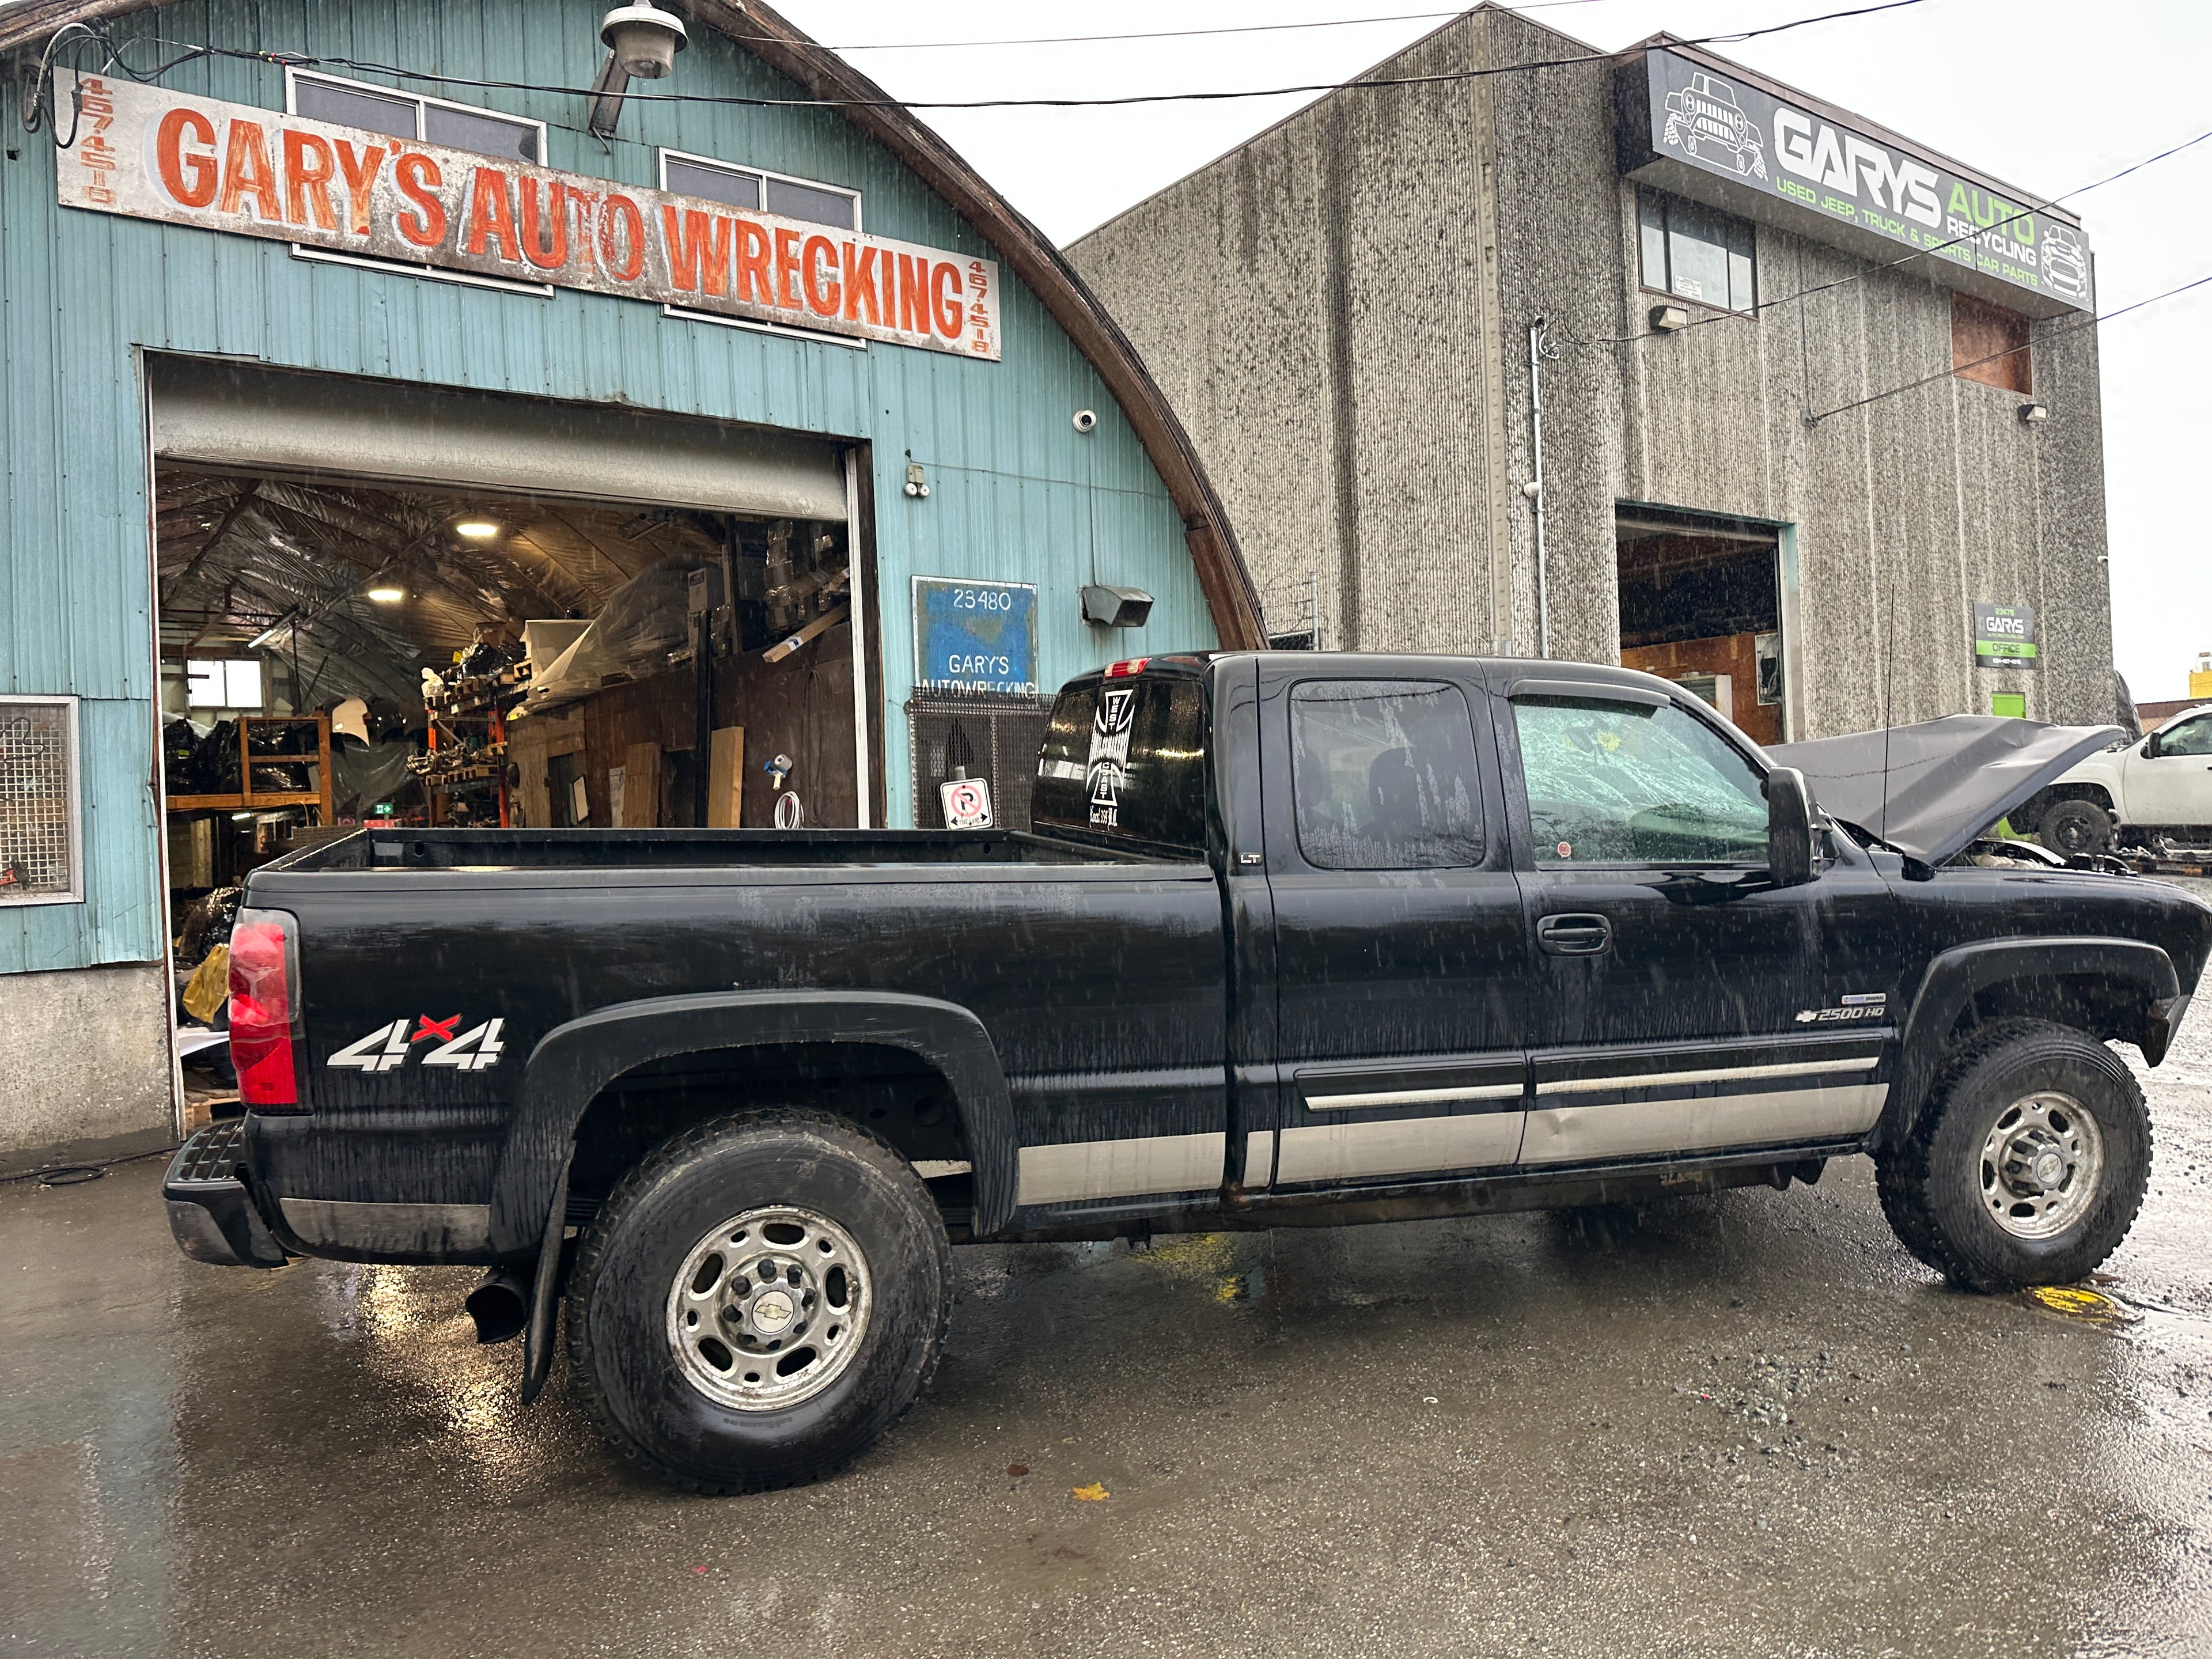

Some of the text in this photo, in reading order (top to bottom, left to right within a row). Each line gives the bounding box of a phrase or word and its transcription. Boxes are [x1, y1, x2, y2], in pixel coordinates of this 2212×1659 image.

[1774, 107, 1942, 229] GARYS
[157, 107, 963, 339] GARY'S AUTO WRECKING
[1947, 181, 2035, 246] AUTO
[1776, 176, 2038, 286] USED JEEP, TRUCK & SPORTS CAR PARTS
[1946, 215, 2037, 267] RECYCLING
[953, 589, 1012, 611] 23480
[1986, 616, 2024, 634] GARYS
[1993, 643, 2020, 653] OFFICE
[949, 654, 1010, 675] GARY'S
[1108, 696, 1121, 730] WEST
[1240, 854, 1260, 863] LT
[1818, 1007, 1885, 1021] 2500 HD
